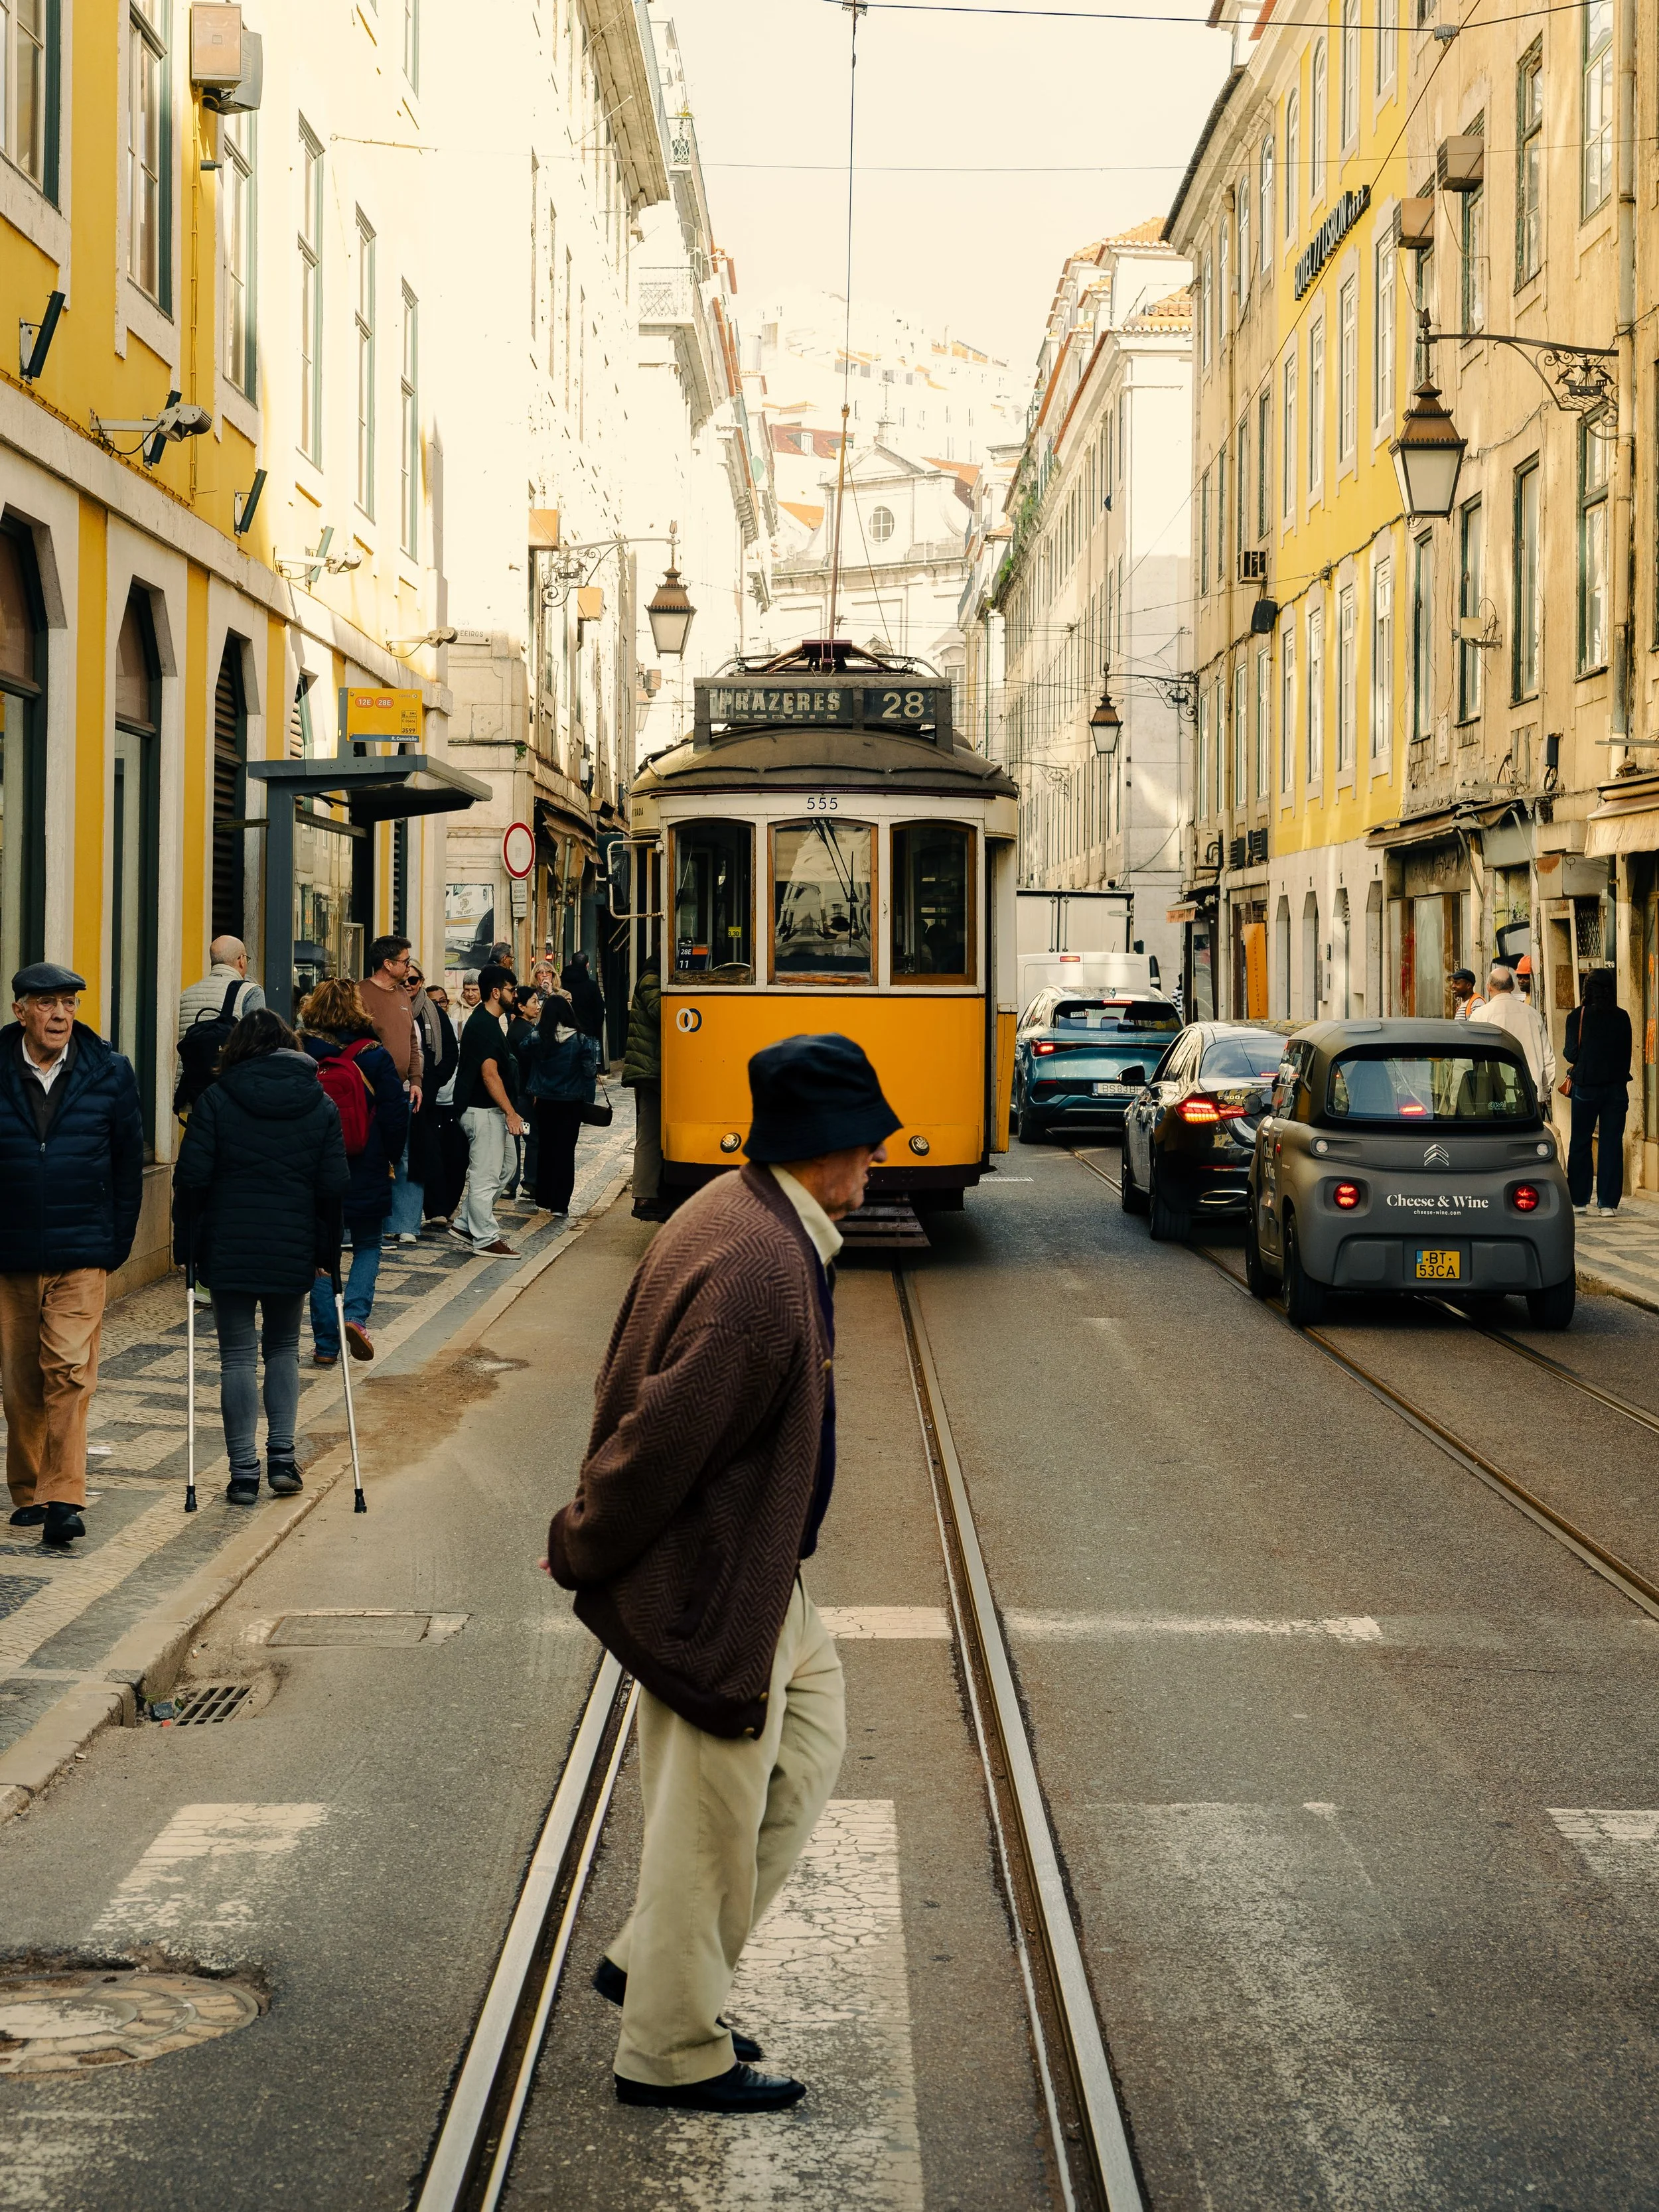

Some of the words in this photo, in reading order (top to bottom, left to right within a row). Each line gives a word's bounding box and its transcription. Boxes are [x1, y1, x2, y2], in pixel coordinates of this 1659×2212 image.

[719, 692, 841, 715] PRAZERES
[882, 691, 925, 719] 28
[806, 797, 838, 810] 555
[679, 960, 689, 969] 11
[1102, 1084, 1116, 1093] BS
[1117, 1085, 1129, 1093] 83
[1386, 1194, 1435, 1207] Cheese
[1437, 1195, 1450, 1208] &
[1452, 1195, 1489, 1208] Wine
[1419, 1265, 1456, 1277] 53CA
